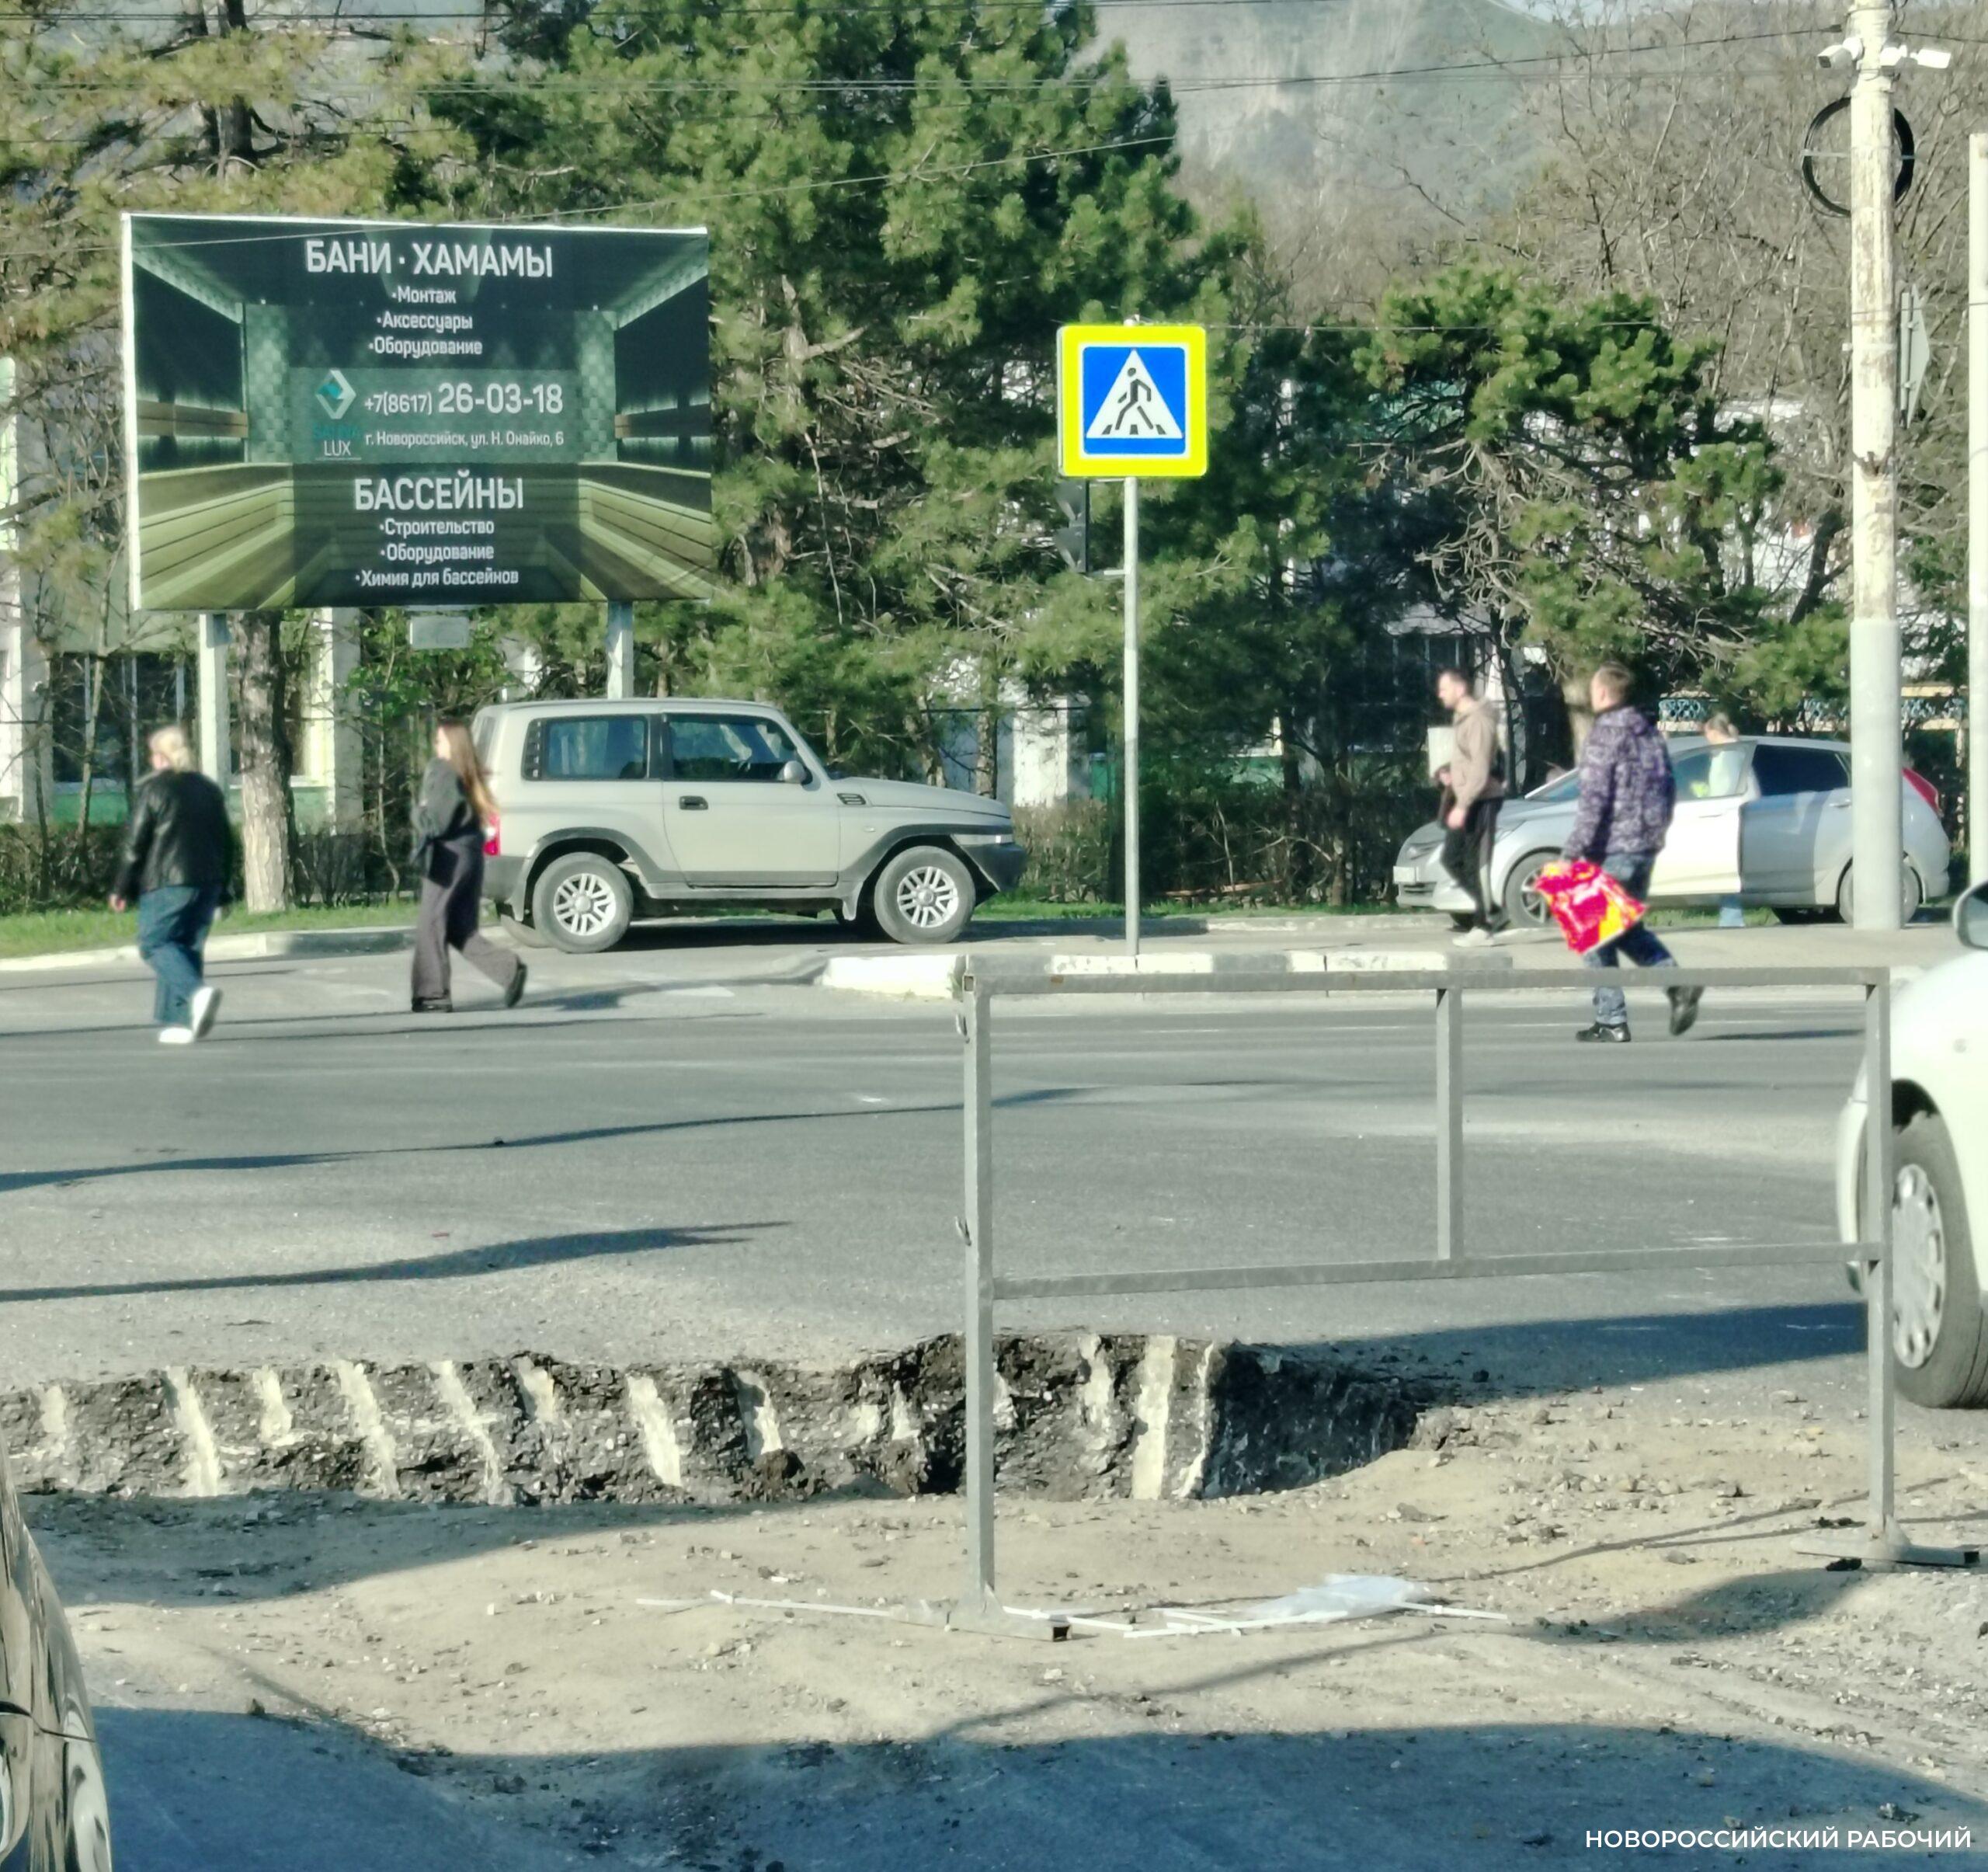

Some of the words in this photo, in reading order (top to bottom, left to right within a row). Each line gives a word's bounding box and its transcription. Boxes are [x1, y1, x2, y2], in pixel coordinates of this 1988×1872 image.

[306, 240, 391, 273] БАНИ
[412, 243, 553, 277] ХАМАМЫ
[398, 286, 456, 304] Монтаж
[382, 311, 472, 333] Аксессуары
[374, 336, 482, 359] Оборудование
[364, 391, 433, 416] +7(8617)
[438, 382, 564, 414] 26-03-18
[324, 440, 351, 456] LUX
[366, 433, 374, 446] г.
[377, 431, 467, 448] Новороссийск,
[471, 433, 488, 449] ул.
[492, 431, 503, 446] Н.
[555, 431, 564, 445] 6
[354, 468, 524, 510] БАССЕЙНЫ
[385, 517, 495, 539] Строительство
[387, 544, 495, 565] Оборудование
[360, 569, 409, 586] Химия
[412, 570, 440, 588] для
[443, 567, 520, 586] бассейнов
